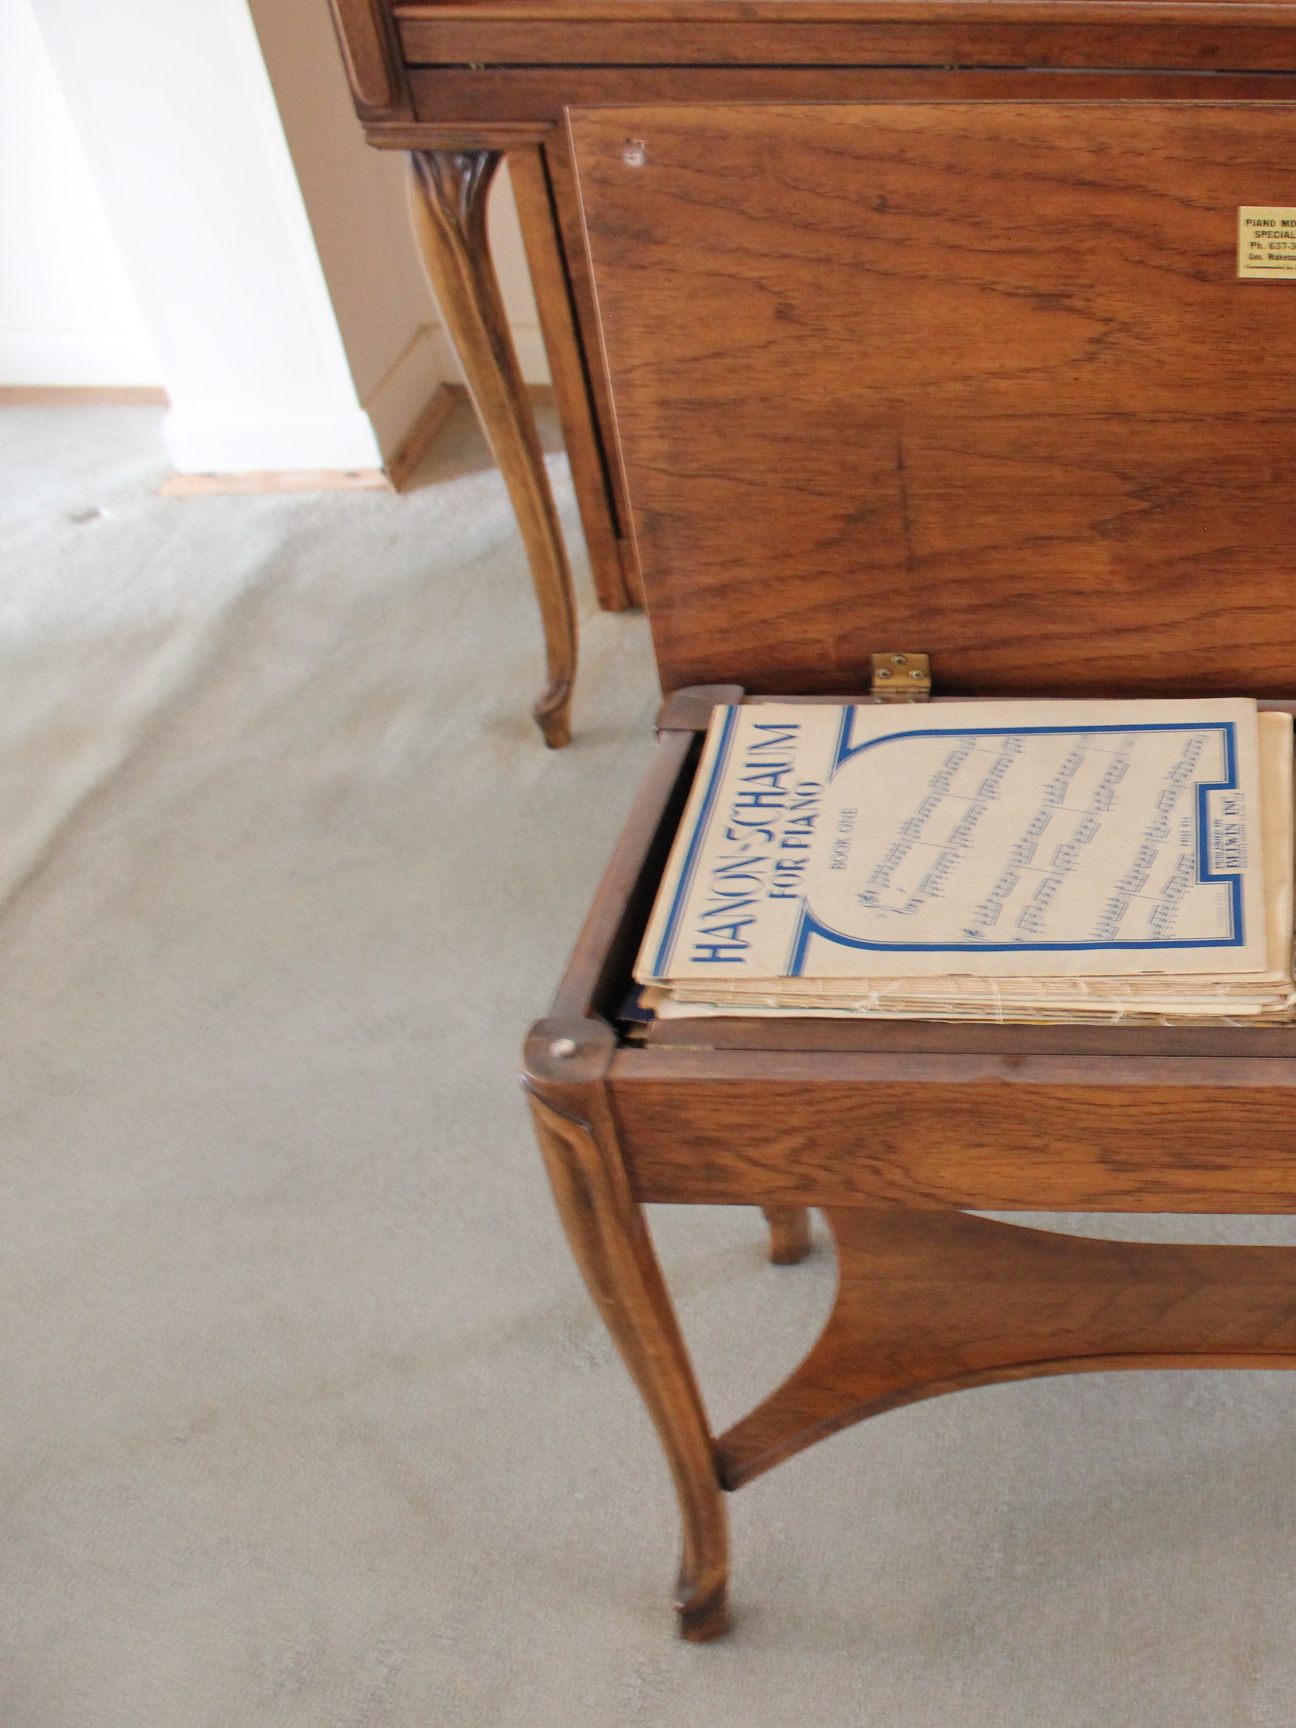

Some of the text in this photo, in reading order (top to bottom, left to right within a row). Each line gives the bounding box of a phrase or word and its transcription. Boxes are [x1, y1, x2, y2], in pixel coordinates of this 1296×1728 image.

[1245, 219, 1276, 228] PIANO
[692, 724, 799, 963] HANON-SCHAUM
[768, 781, 824, 900] FOR PIANO
[828, 807, 858, 871] BOOK ONE
[1224, 823, 1241, 869] BELWIN
